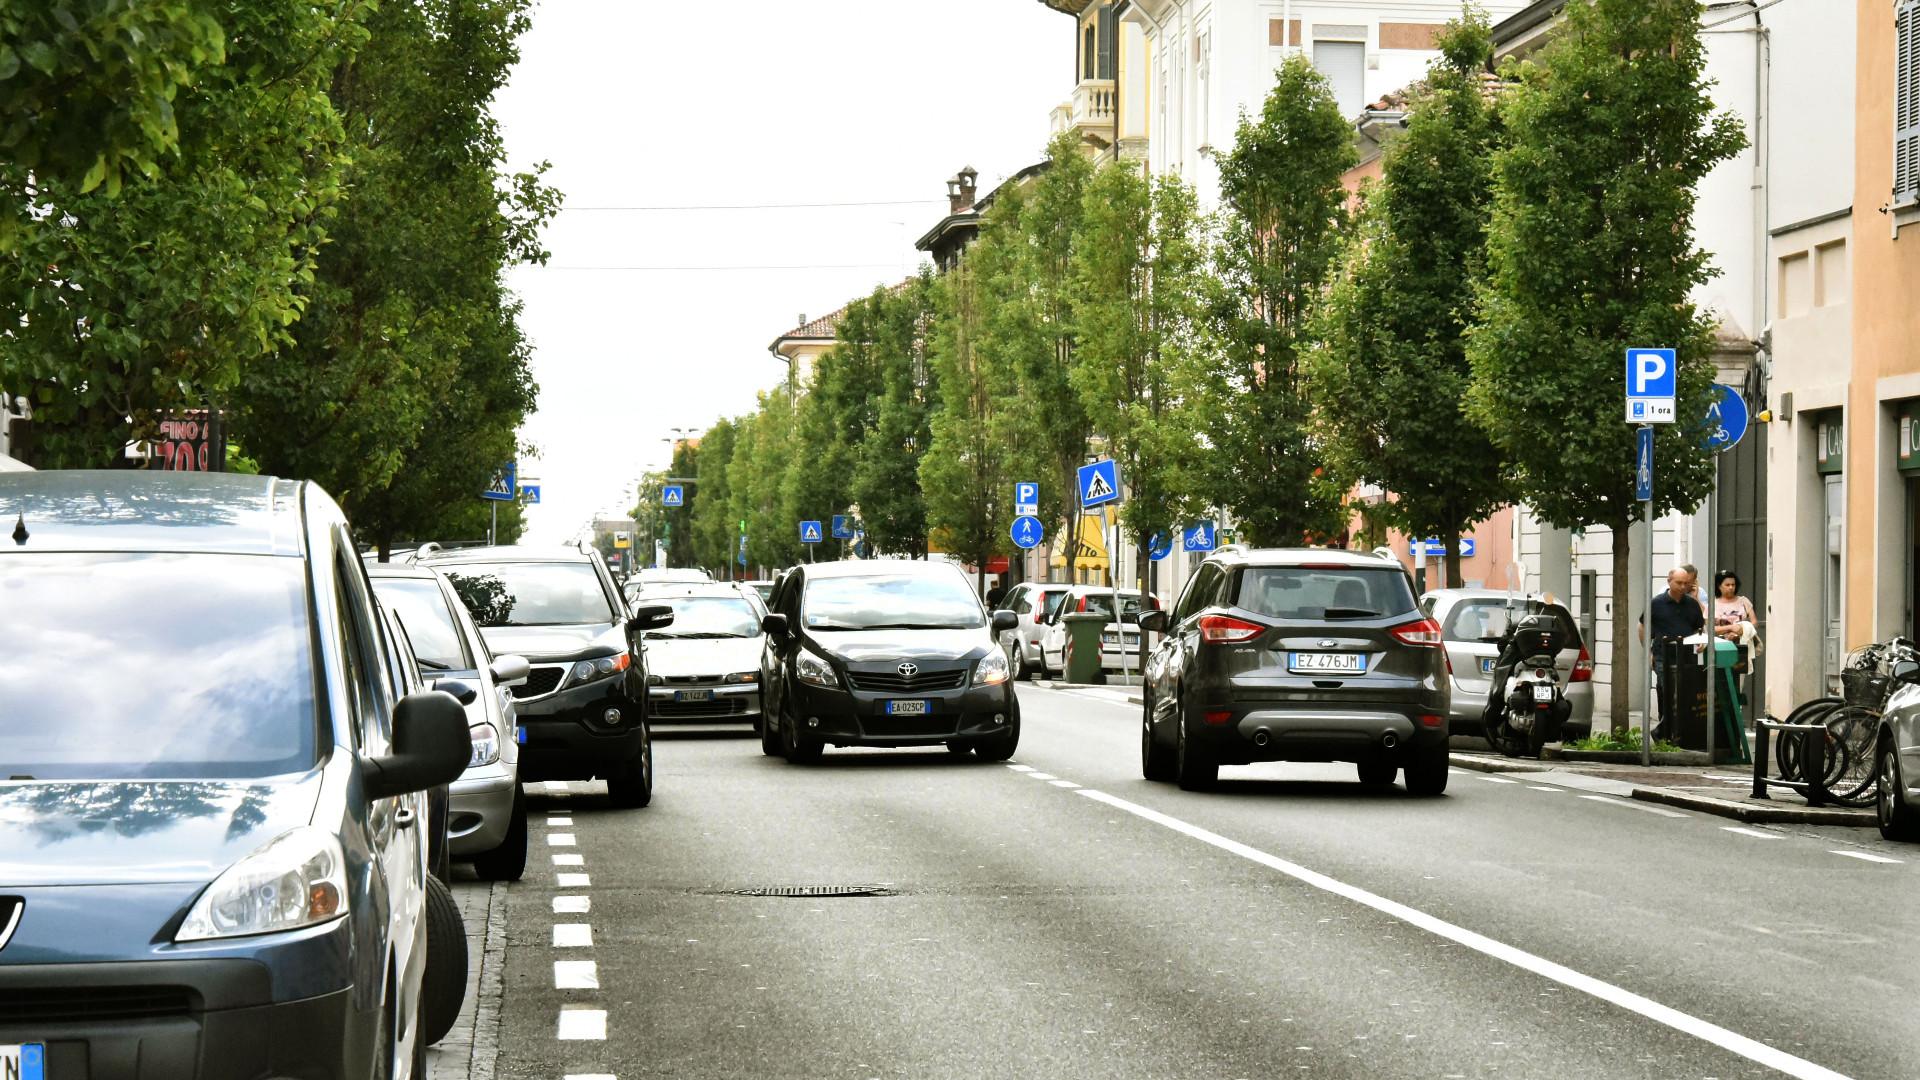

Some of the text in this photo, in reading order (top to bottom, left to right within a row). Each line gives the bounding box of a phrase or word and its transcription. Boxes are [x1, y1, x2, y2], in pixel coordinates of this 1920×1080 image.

[1636, 354, 1667, 393] P
[1651, 406, 1655, 414] 1
[160, 421, 199, 440] FINO
[1021, 485, 1034, 502] P
[1297, 654, 1358, 669] EZ 476JM
[891, 702, 900, 713] EA
